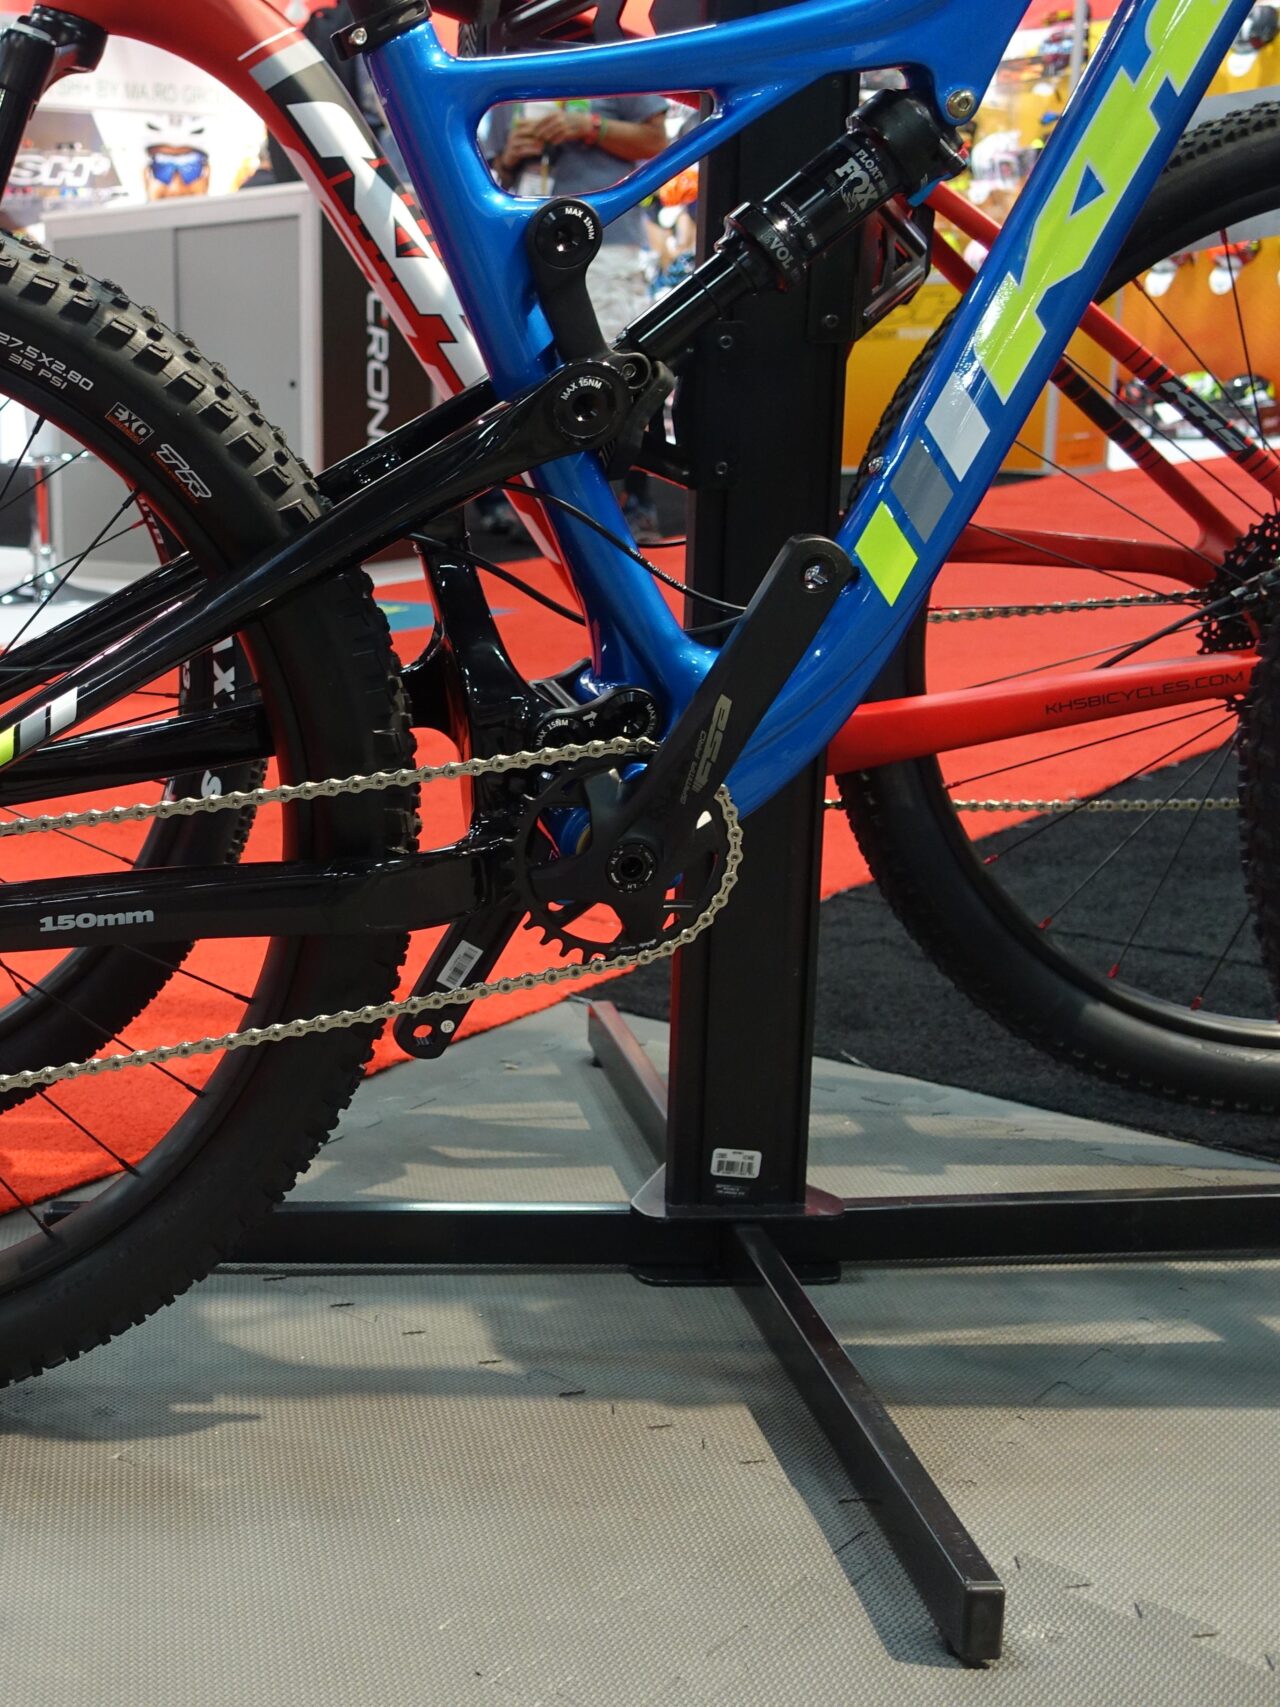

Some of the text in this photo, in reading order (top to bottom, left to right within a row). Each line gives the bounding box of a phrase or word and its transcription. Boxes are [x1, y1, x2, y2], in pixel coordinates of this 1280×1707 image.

[855, 149, 883, 183] FLOAT
[835, 157, 879, 212] FOX
[565, 208, 595, 240] MAX 15NM
[8, 353, 68, 390] 35 PSI
[560, 378, 602, 400] MAX 15NM
[112, 404, 152, 439] EXO
[157, 443, 212, 499] TR
[1045, 671, 1243, 715] KHSBICYCLES.COM
[536, 729, 548, 746] MAX
[39, 909, 155, 932] 150mm
